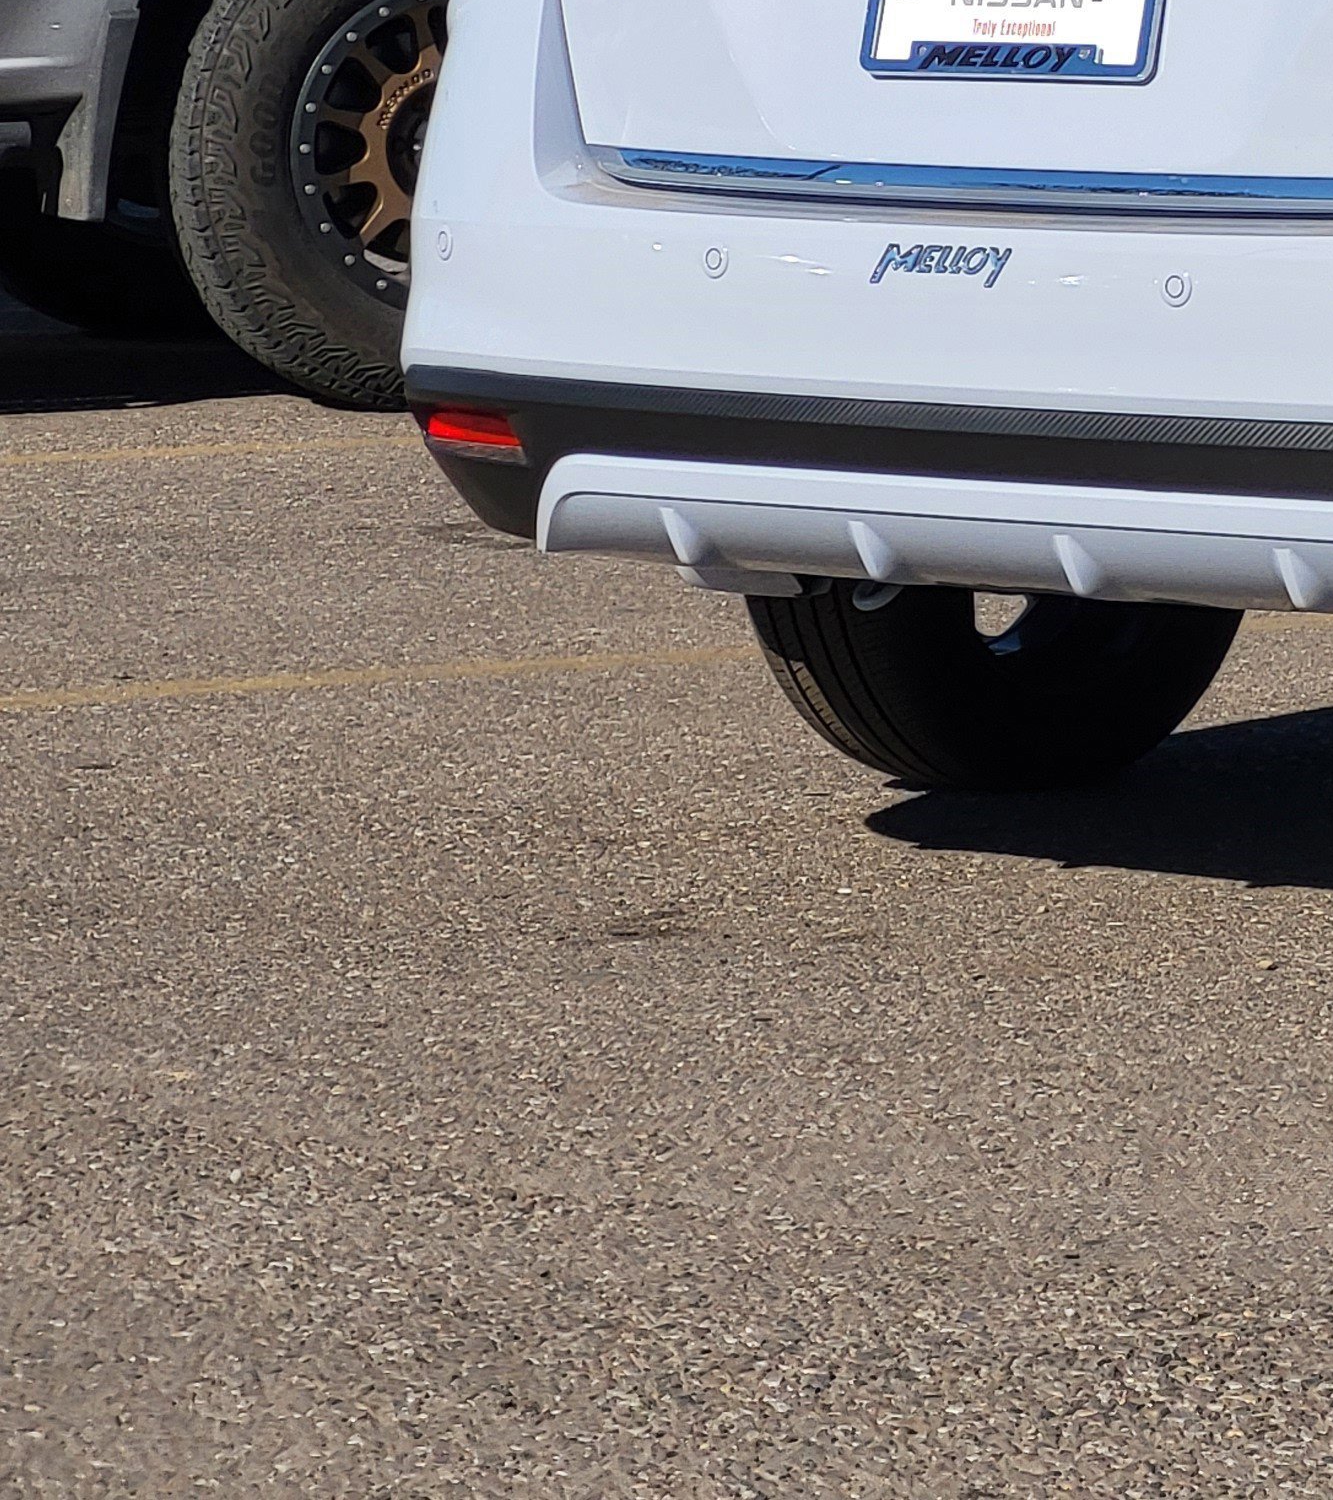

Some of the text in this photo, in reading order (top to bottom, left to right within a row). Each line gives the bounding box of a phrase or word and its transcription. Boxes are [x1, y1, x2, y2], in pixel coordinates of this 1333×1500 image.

[973, 18, 997, 38] Truly
[918, 44, 1077, 73] MELLOY
[869, 243, 1013, 289] MELLOY
